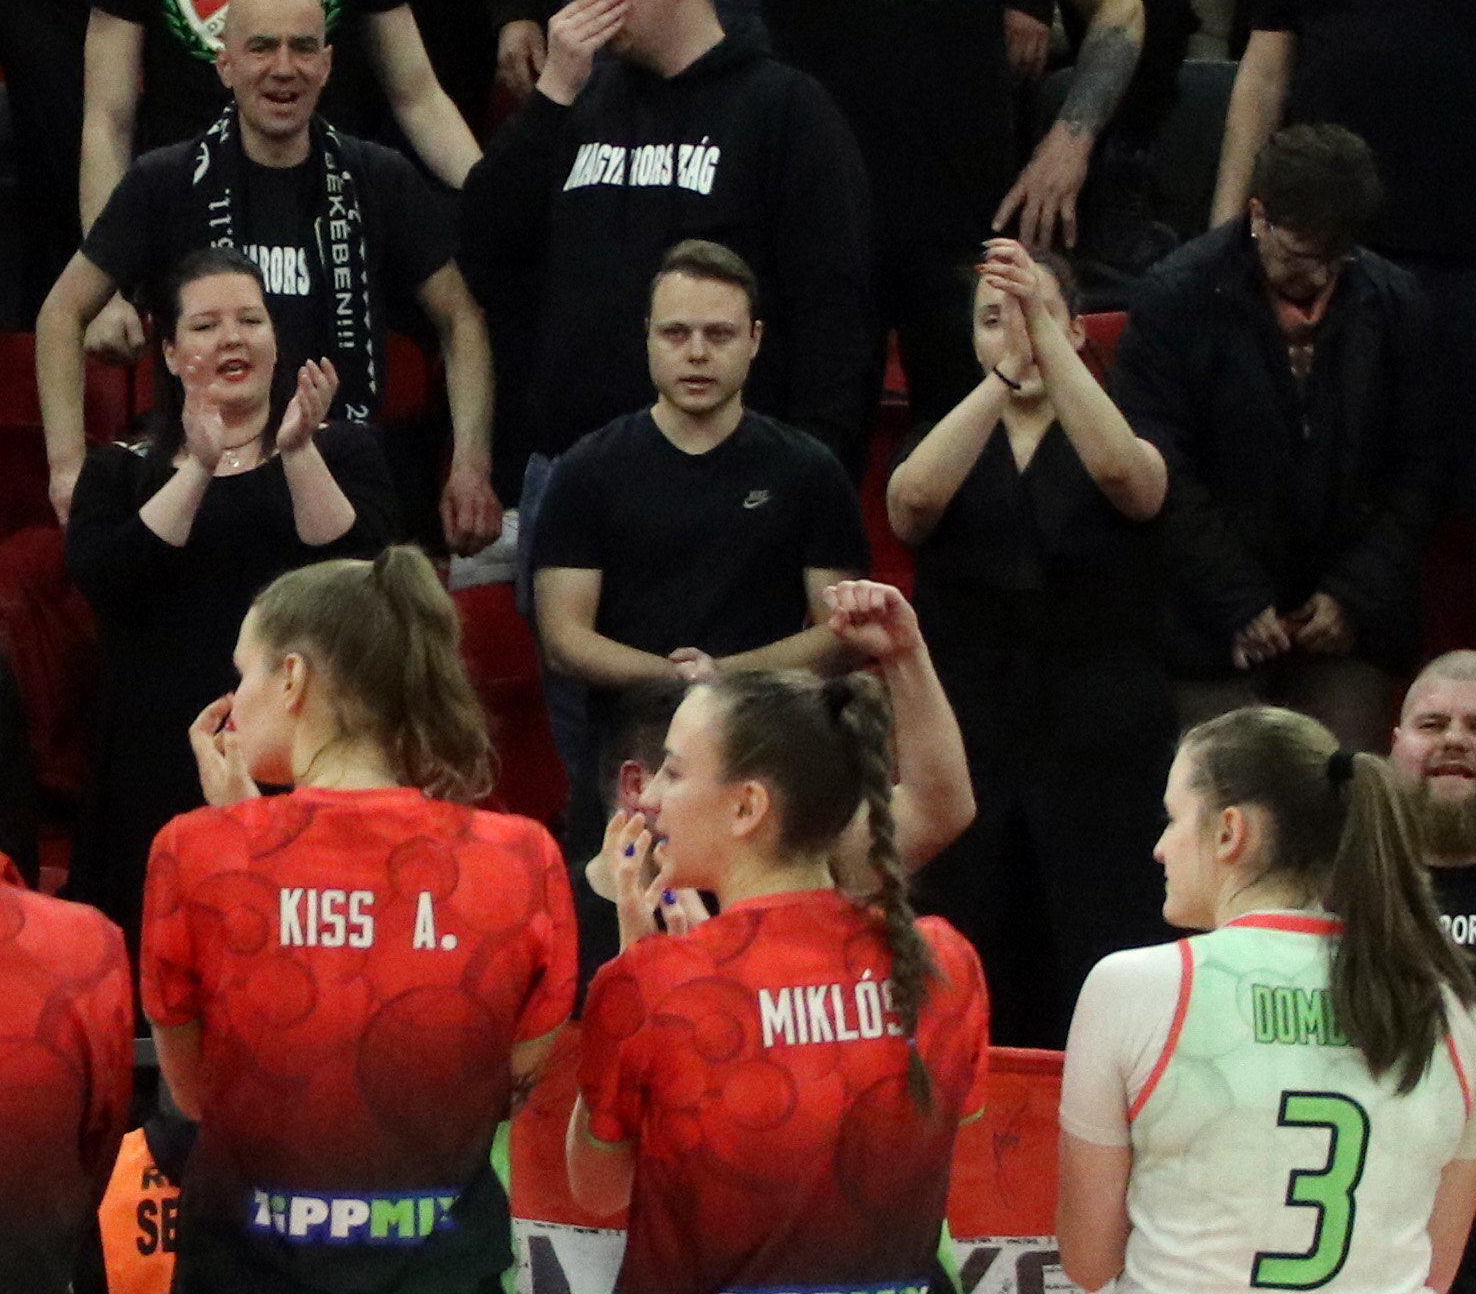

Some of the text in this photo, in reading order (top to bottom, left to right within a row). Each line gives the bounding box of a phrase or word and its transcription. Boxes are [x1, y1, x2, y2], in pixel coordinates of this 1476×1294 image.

[280, 887, 458, 951] KISS A.
[1249, 1090, 1372, 1291] 3
